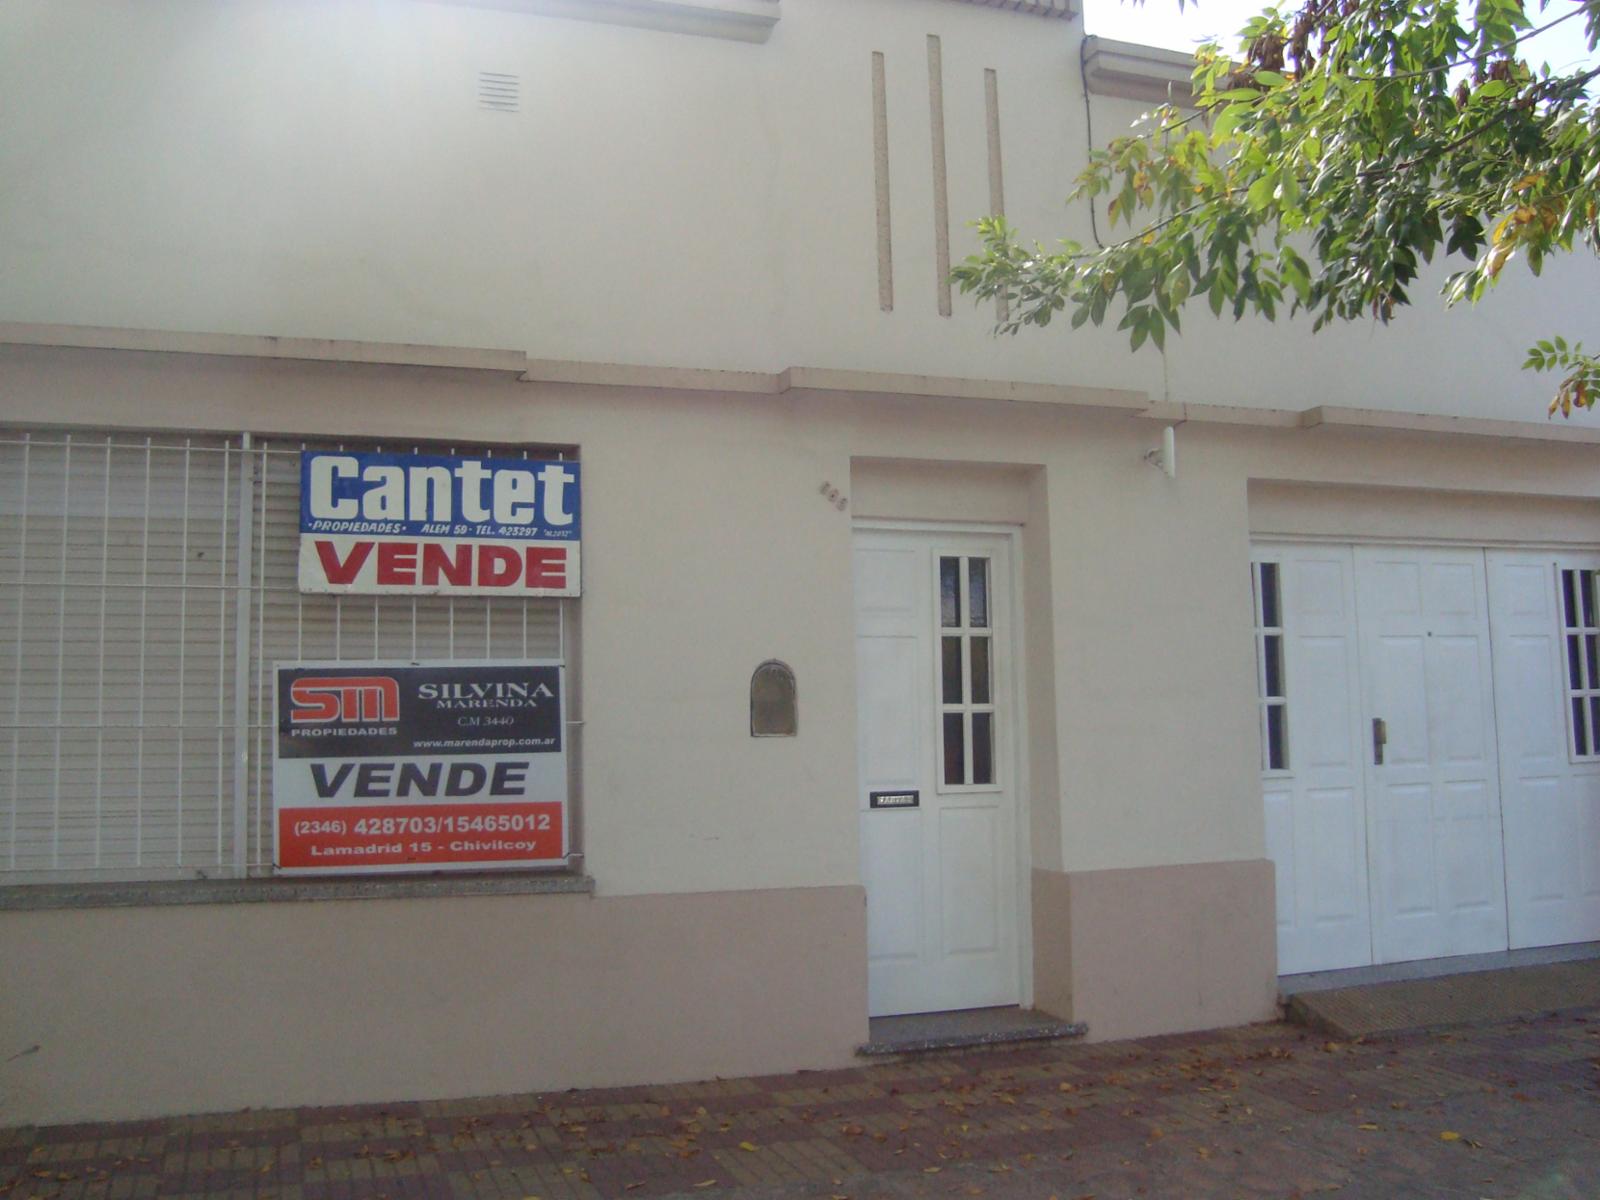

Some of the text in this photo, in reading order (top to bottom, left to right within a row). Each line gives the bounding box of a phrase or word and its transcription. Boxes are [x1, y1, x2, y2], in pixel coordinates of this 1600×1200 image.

[310, 455, 575, 526] Cantet
[421, 523, 449, 535] ALEM
[475, 525, 495, 536] TEL.
[314, 540, 567, 589] VENDE
[417, 682, 554, 699] SILVINA
[436, 698, 537, 709] MARENDA
[482, 715, 514, 726] 3440
[291, 727, 398, 737] PROPIEDADES
[413, 737, 555, 748] www.marendaprop.com.ar
[310, 761, 530, 798] VENDE
[294, 814, 551, 836] (2346) 428703/15465012
[311, 843, 403, 856] Lamadrid
[409, 841, 432, 852] 15
[450, 839, 537, 852] Chivilcoy
